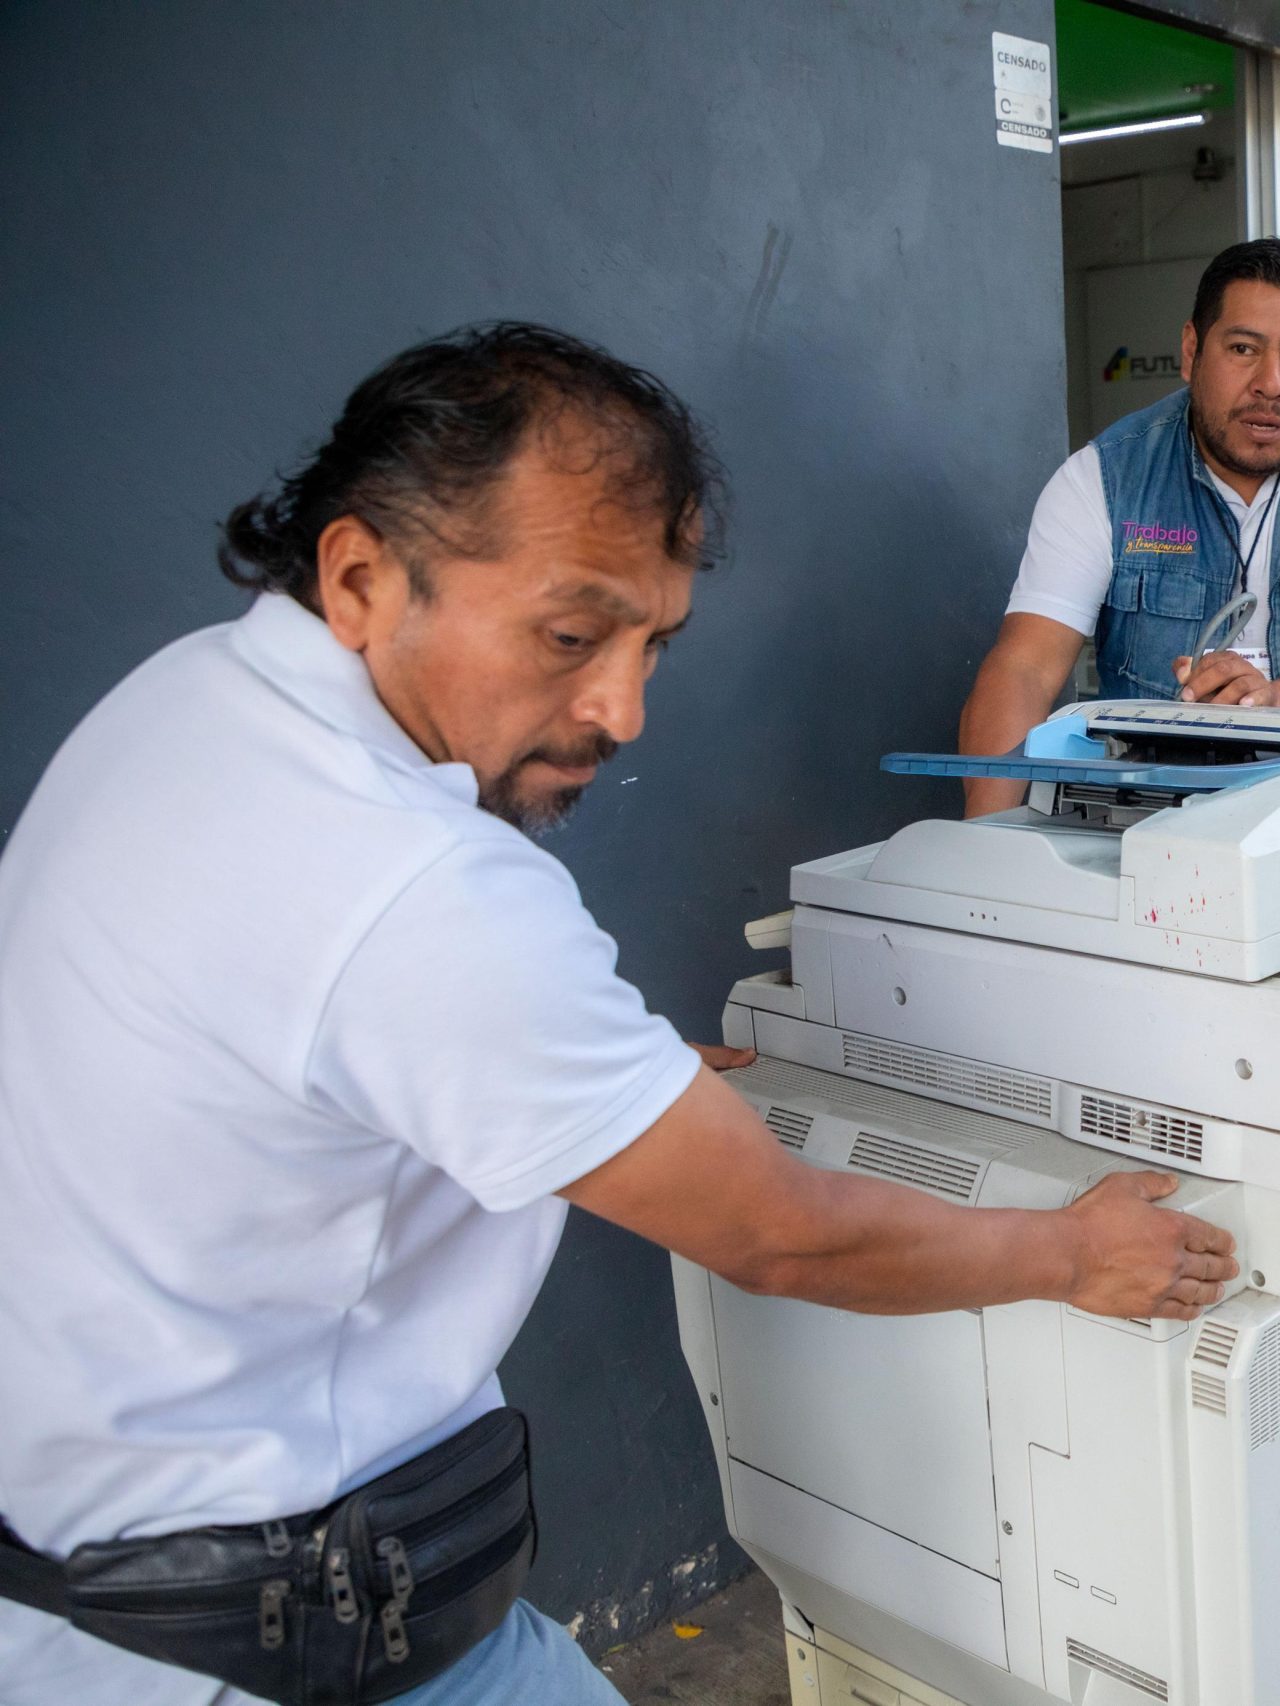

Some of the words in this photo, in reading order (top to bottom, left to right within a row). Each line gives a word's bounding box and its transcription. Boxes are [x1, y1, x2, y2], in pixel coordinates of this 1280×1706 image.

[997, 51, 1047, 73] CENSADO
[1001, 121, 1048, 138] CENSADO
[1122, 521, 1198, 545] Trabajo
